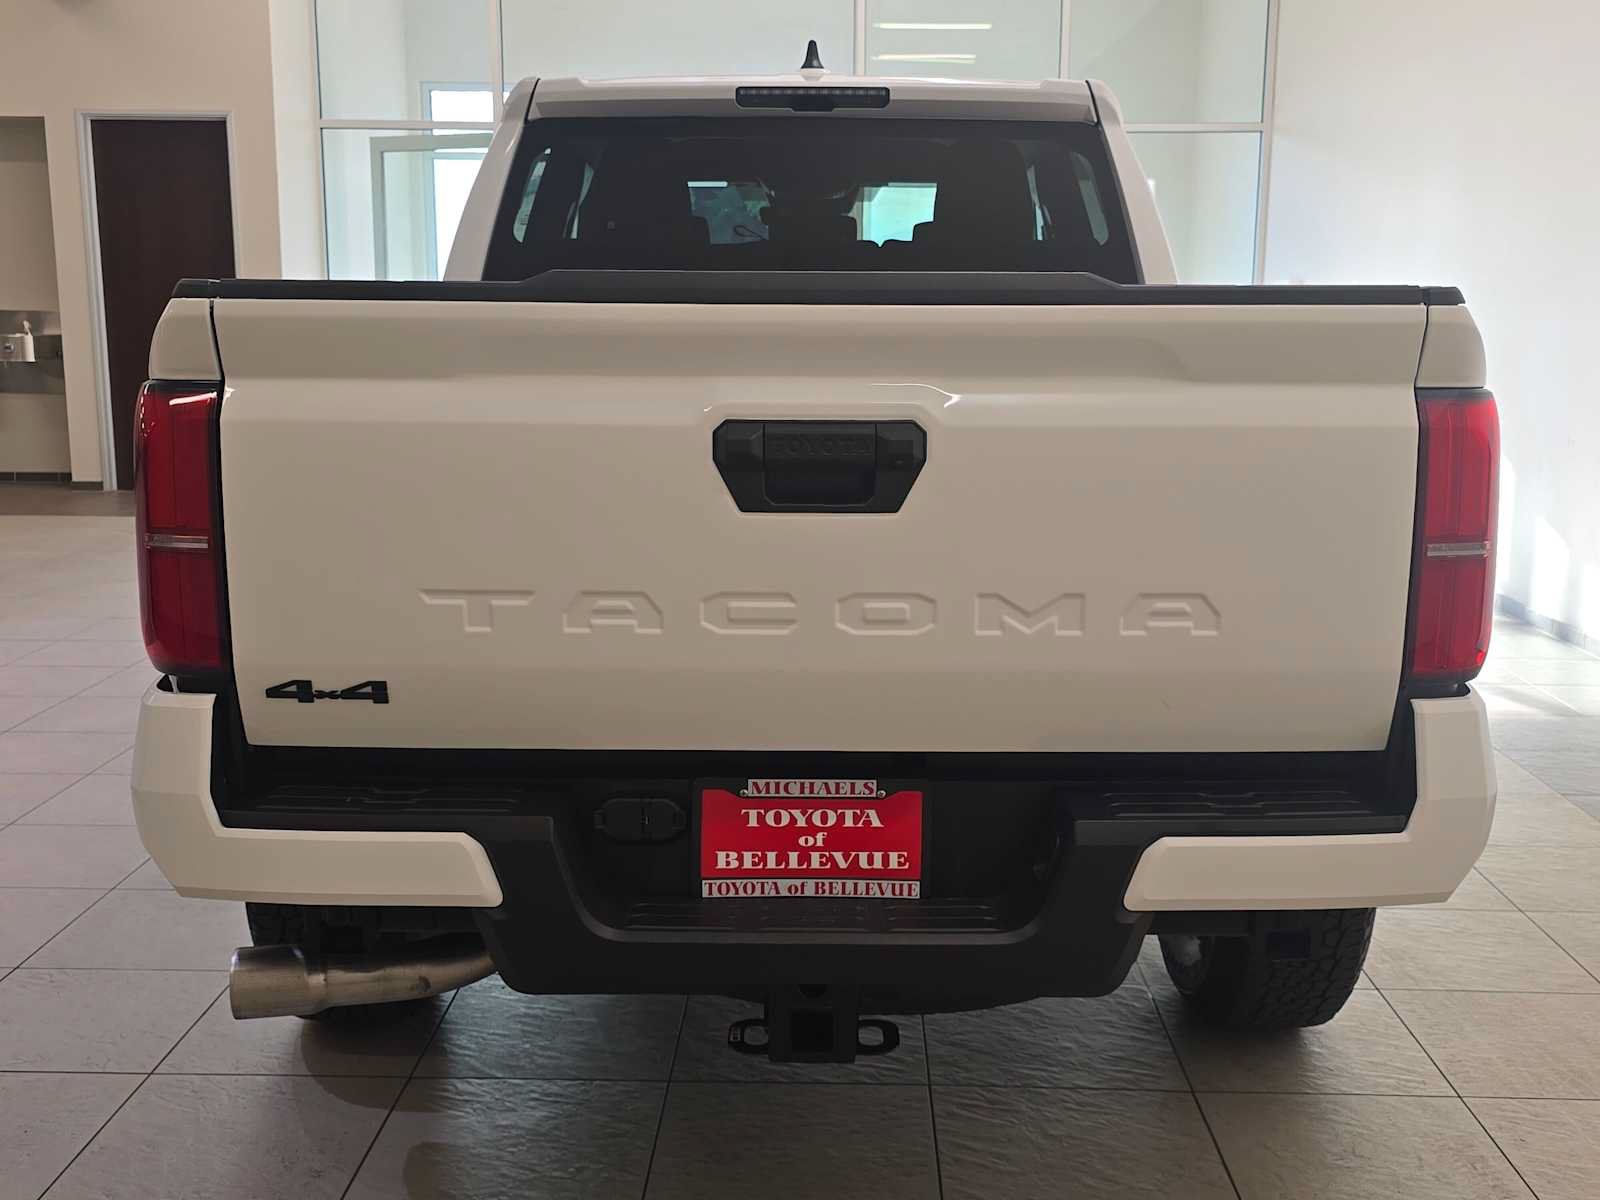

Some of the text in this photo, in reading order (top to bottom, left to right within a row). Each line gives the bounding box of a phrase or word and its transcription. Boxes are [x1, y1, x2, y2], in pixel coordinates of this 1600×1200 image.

[420, 588, 1222, 637] TACOMA
[751, 781, 875, 796] MICHAELS
[741, 808, 884, 828] TOYOTA
[798, 832, 828, 848] of
[715, 851, 910, 870] BELLEVUE
[704, 881, 919, 897] TOYOTA of BELLEVUE
